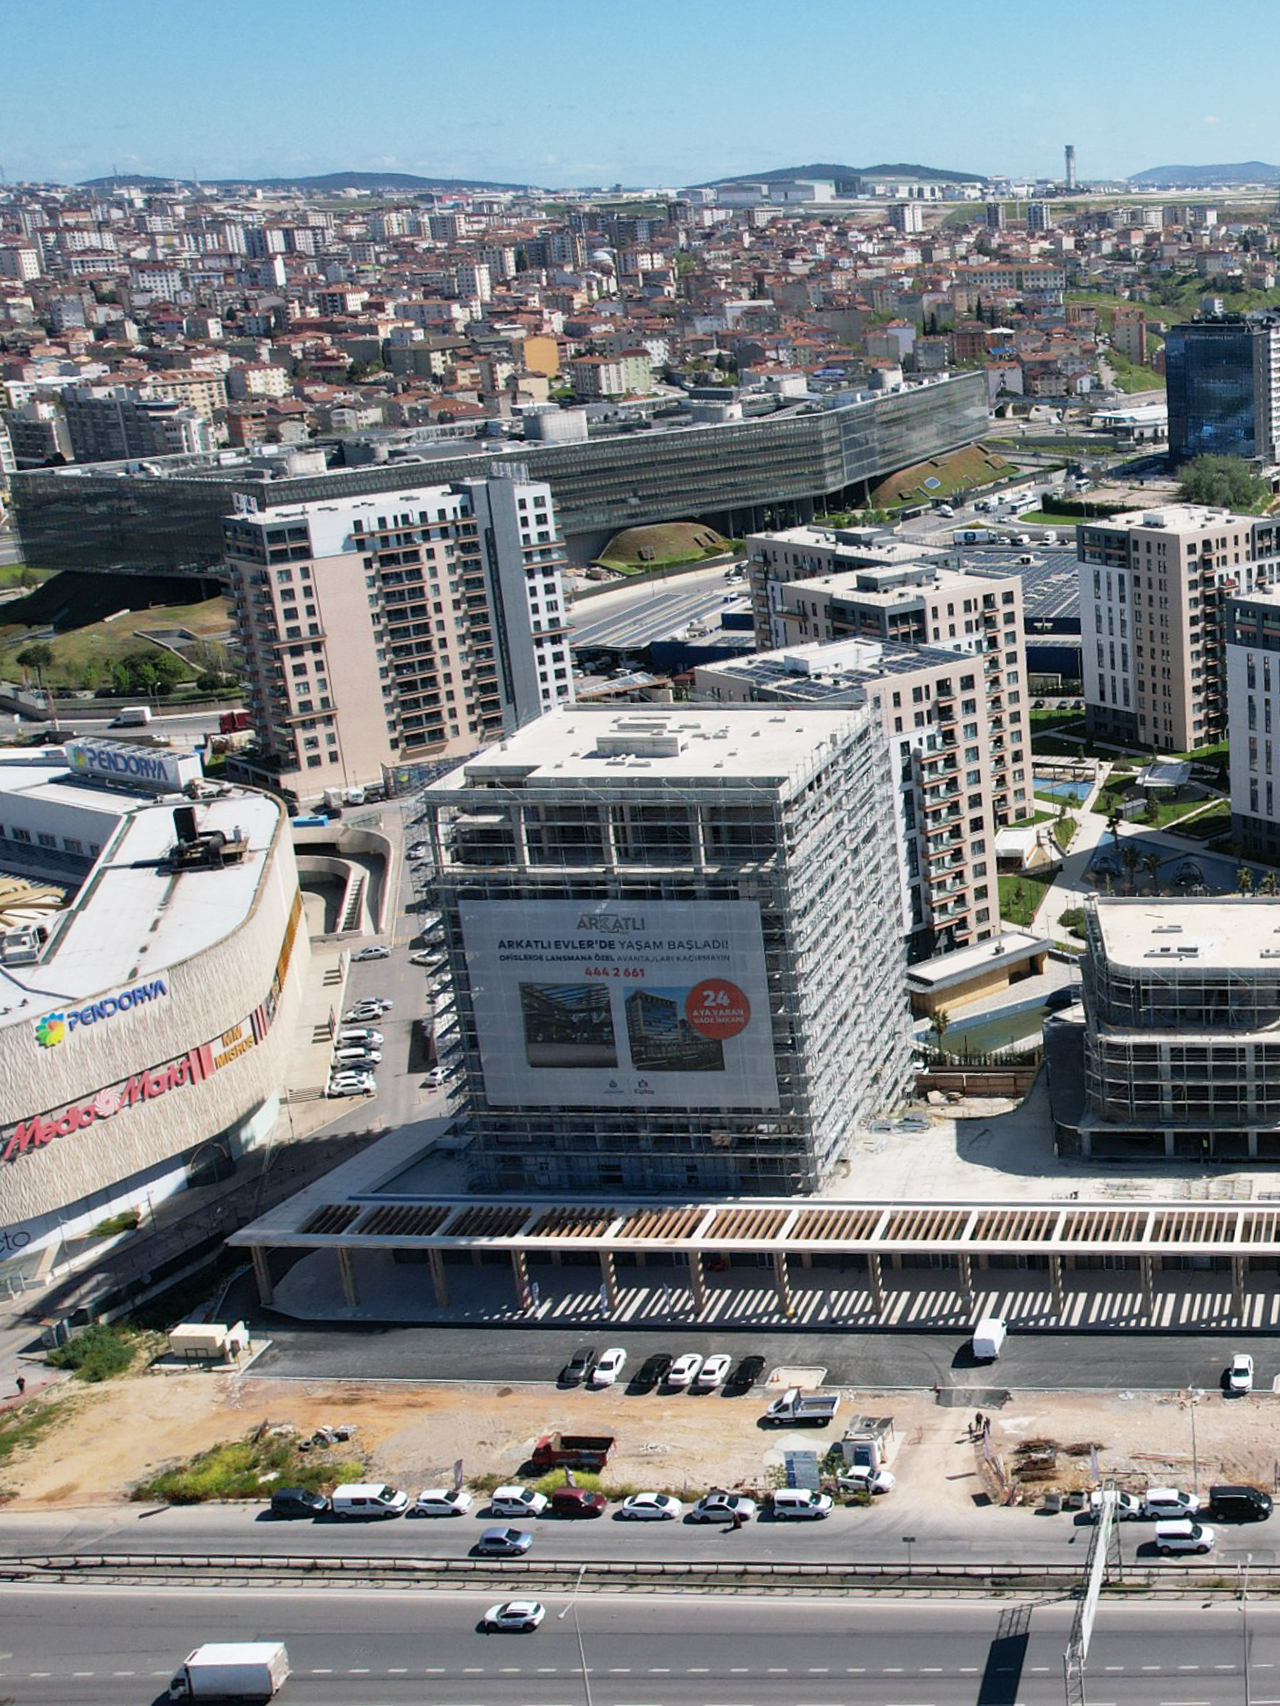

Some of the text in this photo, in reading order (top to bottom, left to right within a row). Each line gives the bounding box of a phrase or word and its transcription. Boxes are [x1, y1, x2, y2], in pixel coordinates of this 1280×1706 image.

[85, 747, 169, 781] PENDORYA
[576, 914, 645, 932] ARKATLI
[498, 939, 729, 951] ARKATLI EVLER'DE YAŞAM BAŞLADI!
[594, 952, 615, 962] ÖZEL
[584, 966, 645, 978] 444 2 661
[66, 979, 168, 1033] PENDORYA
[702, 990, 731, 1007] 24
[213, 1035, 254, 1071] MIGROS
[2, 1057, 192, 1162] Media Markt
